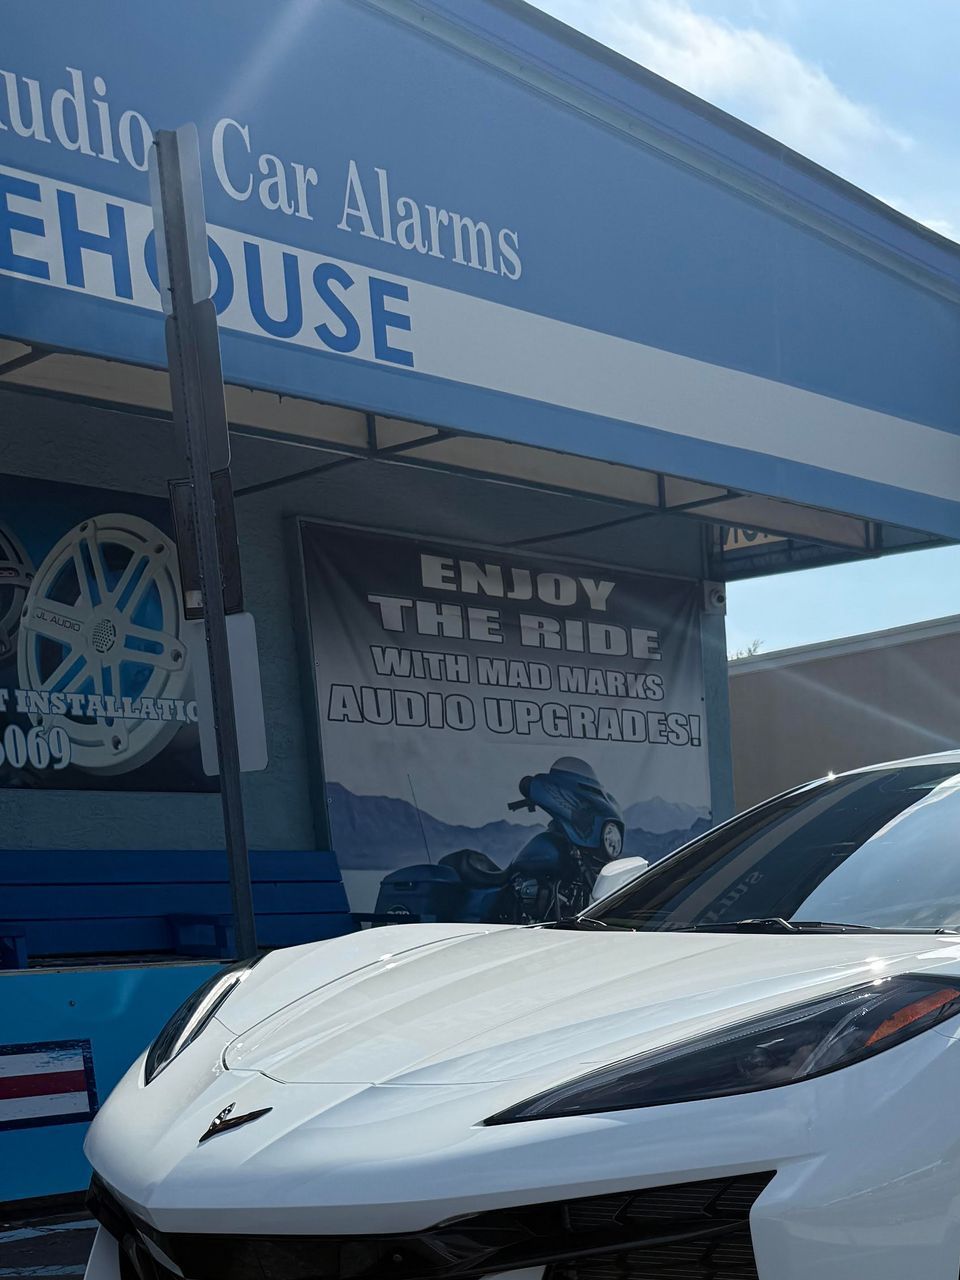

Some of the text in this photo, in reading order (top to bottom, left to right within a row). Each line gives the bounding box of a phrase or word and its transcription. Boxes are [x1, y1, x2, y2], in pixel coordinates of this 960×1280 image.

[0, 67, 522, 280] udio Car Alarms
[420, 553, 616, 612] ENJOY
[36, 609, 81, 632] JL AUDIO
[367, 593, 663, 661] THE RIDE
[369, 645, 665, 701] WITH MAD MARKS
[327, 684, 702, 747] AUDIO UPGRADES!
[0, 724, 71, 770] 069
